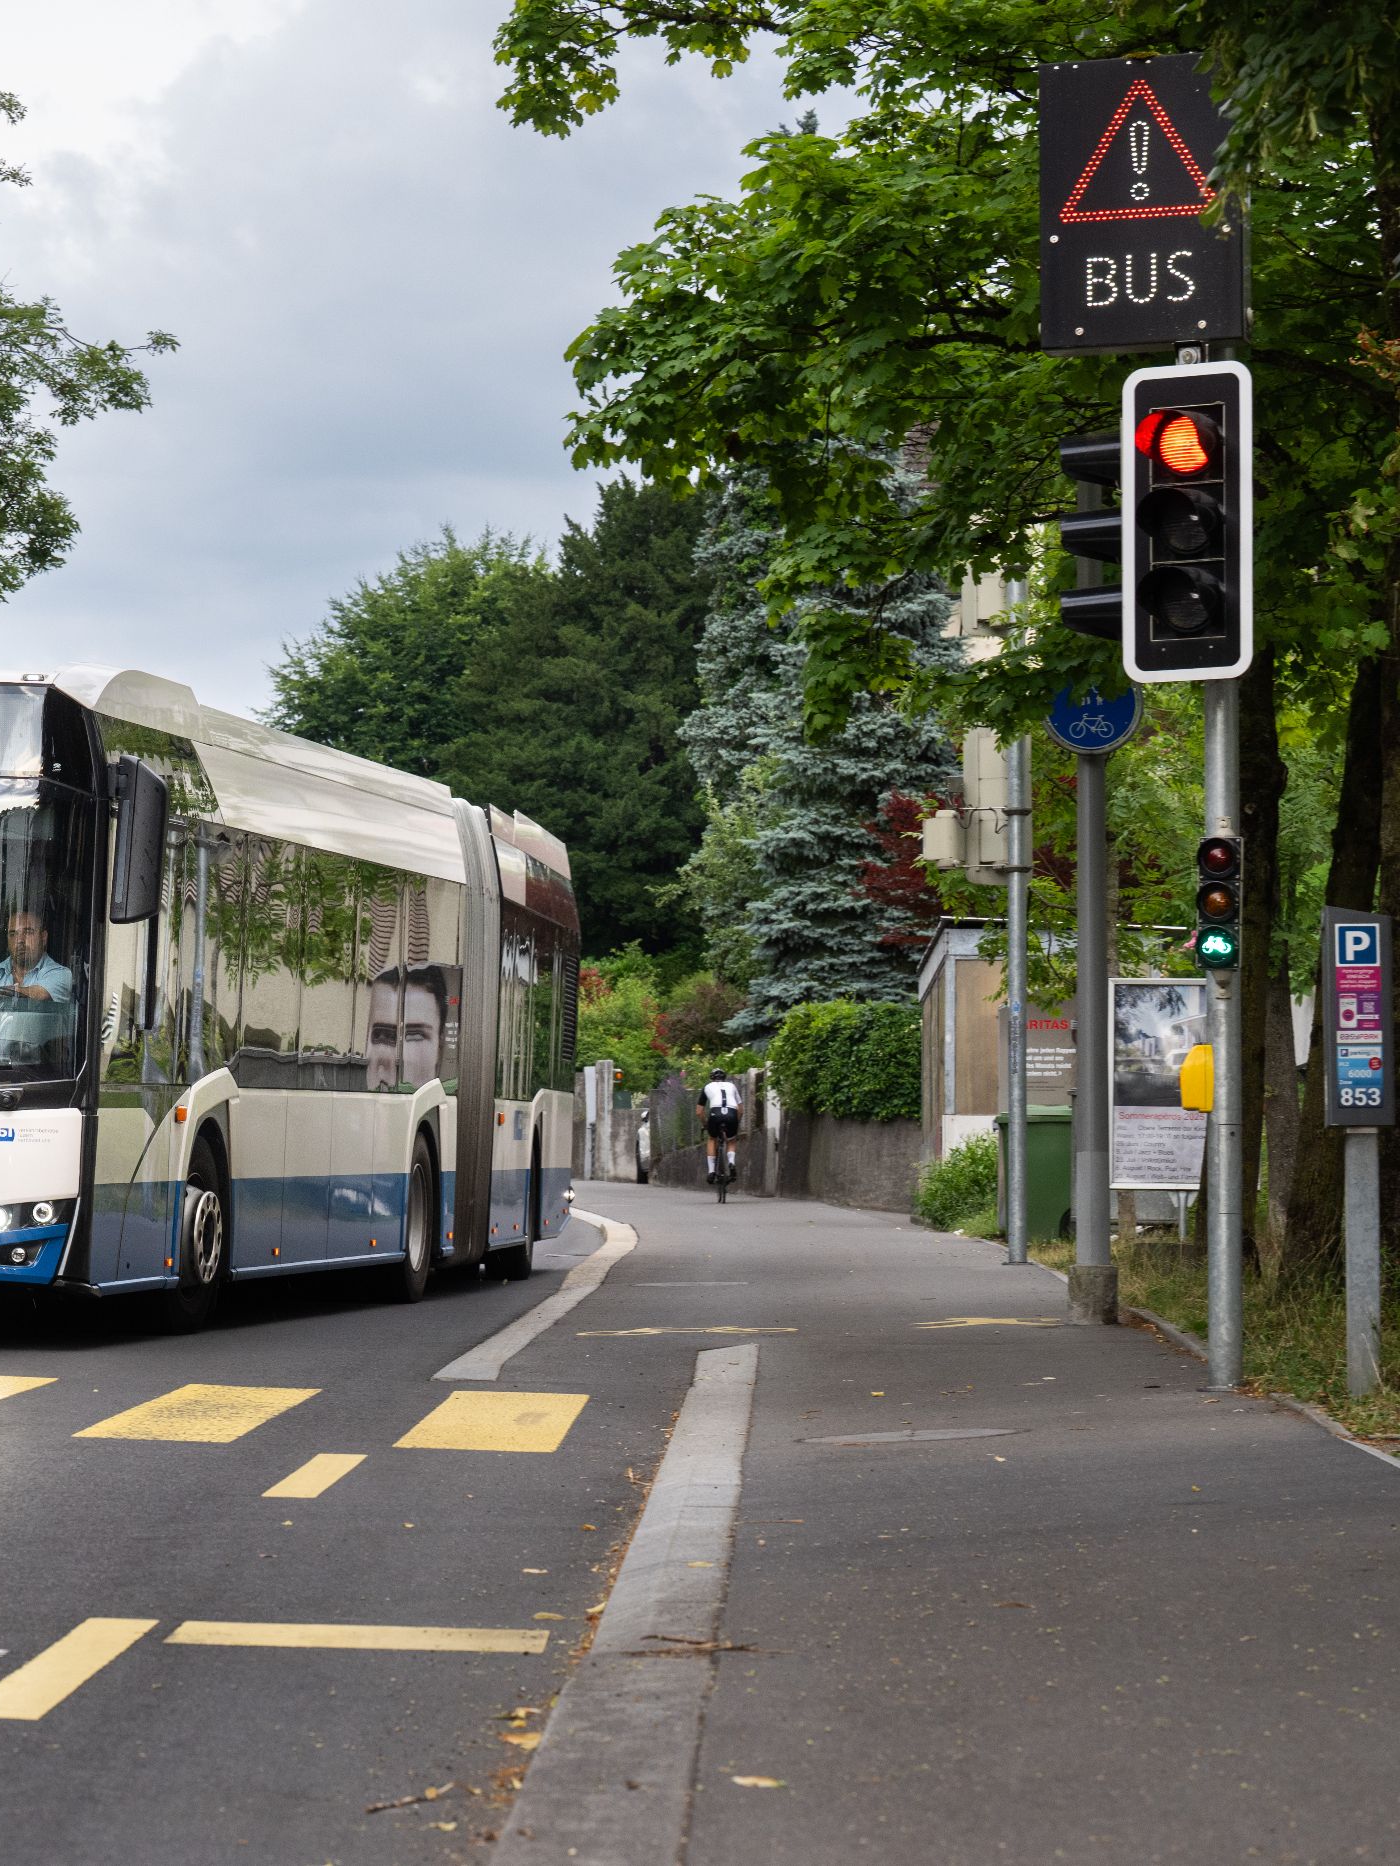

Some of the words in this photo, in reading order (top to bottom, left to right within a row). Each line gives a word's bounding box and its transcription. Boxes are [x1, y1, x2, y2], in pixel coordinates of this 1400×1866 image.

[1086, 251, 1196, 307] BUS
[1345, 930, 1371, 961] P
[1025, 1019, 1070, 1030] RITAS
[1340, 1087, 1381, 1106] 853
